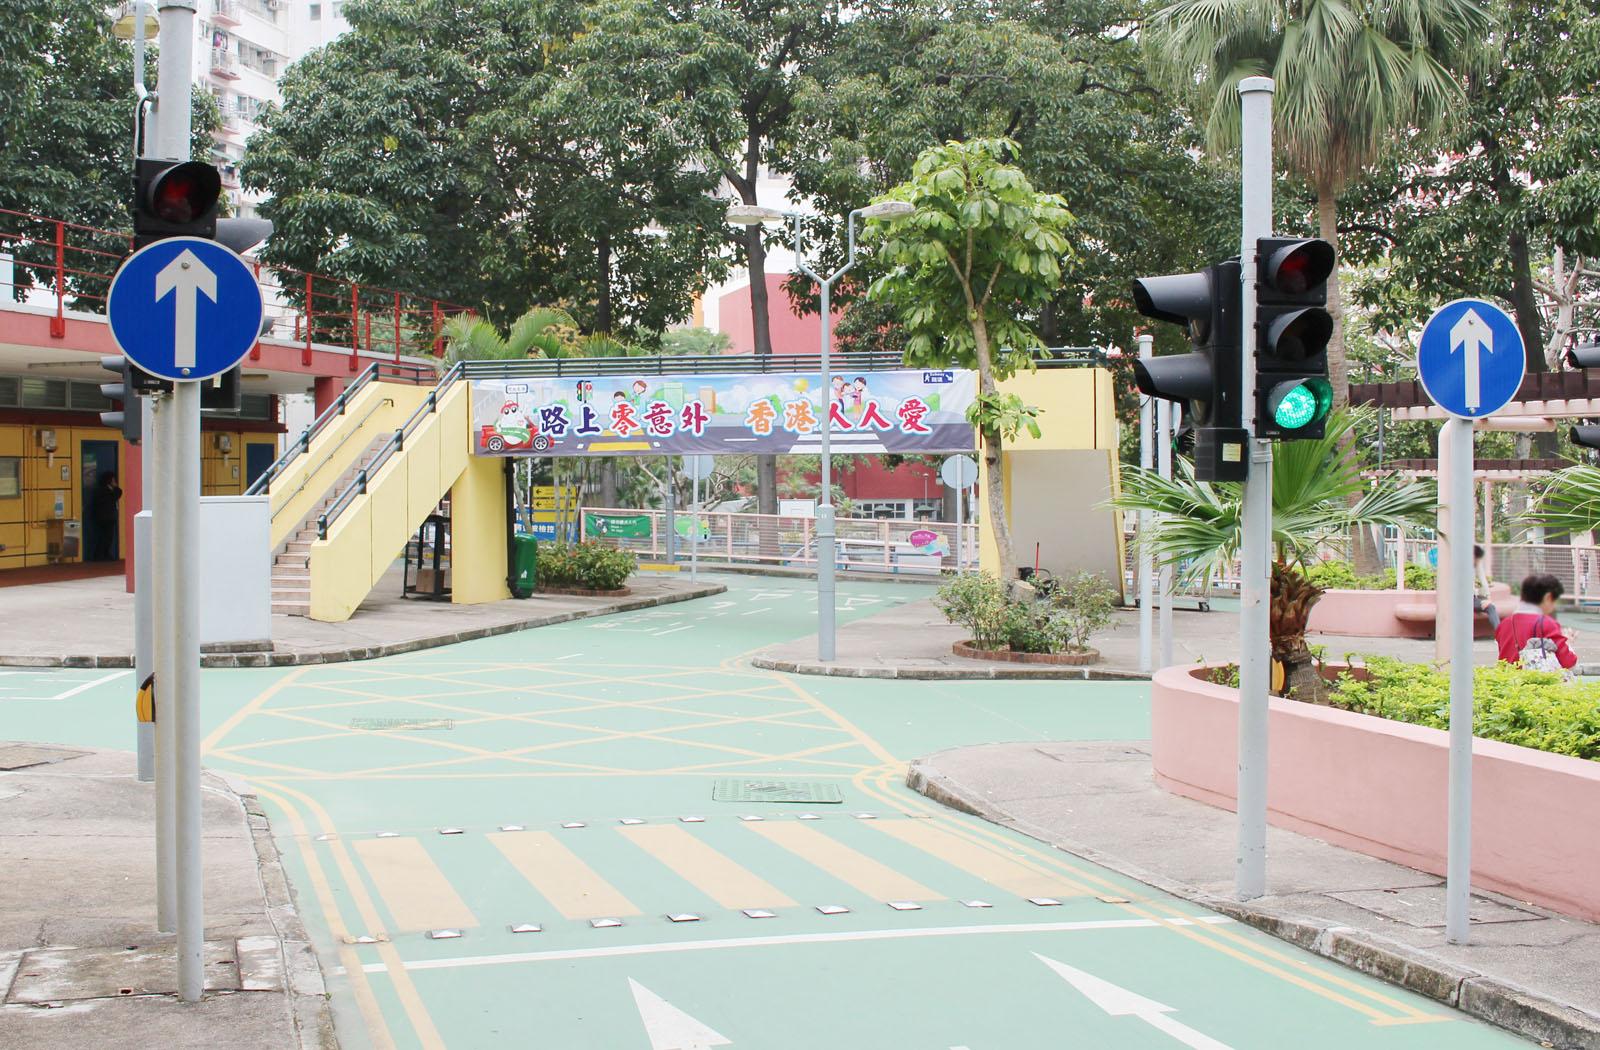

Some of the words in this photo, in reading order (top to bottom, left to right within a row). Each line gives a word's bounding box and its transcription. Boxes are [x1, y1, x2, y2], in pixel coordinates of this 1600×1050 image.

[540, 402, 709, 436] 路上零意外
[746, 398, 930, 433] 香港人人愛
